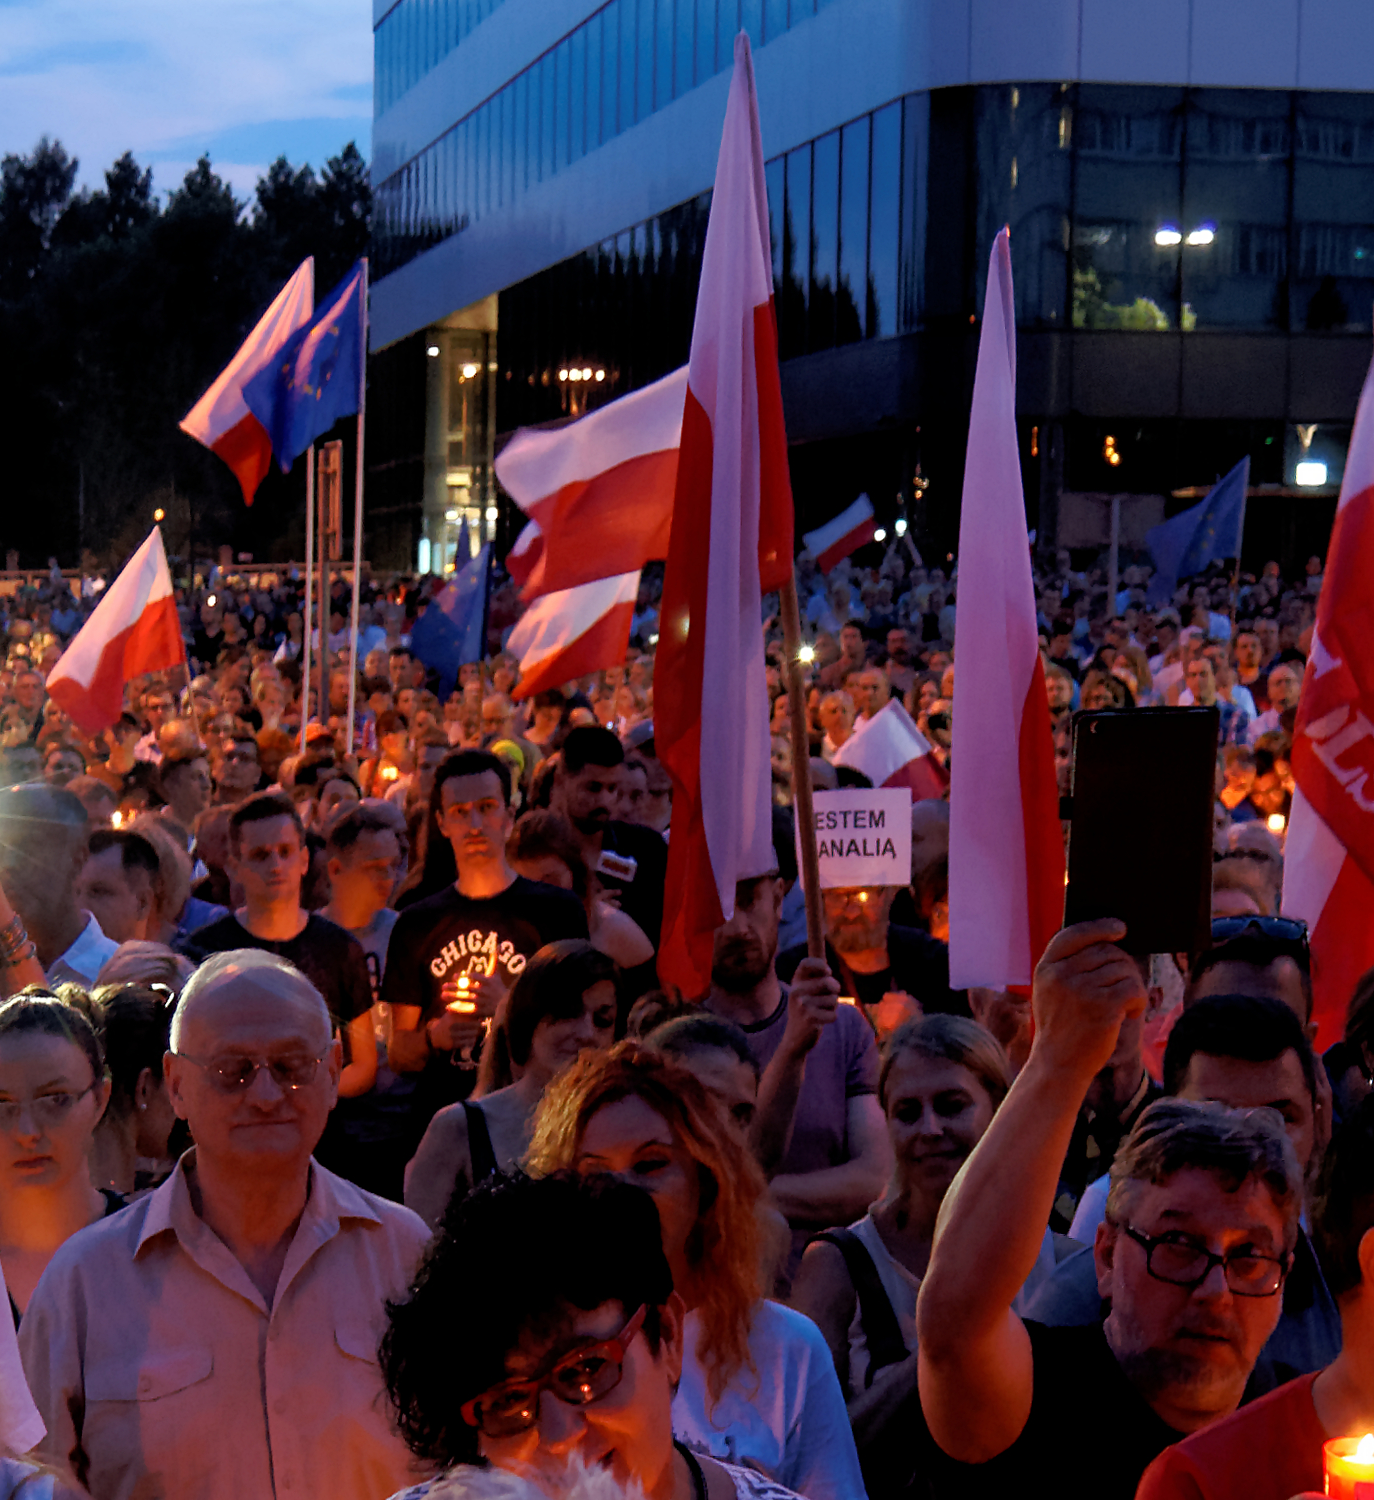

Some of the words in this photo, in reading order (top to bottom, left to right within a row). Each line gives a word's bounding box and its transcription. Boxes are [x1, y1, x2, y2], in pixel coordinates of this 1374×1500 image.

[814, 808, 886, 830] ESTEM
[817, 837, 897, 859] ANALIĄ
[429, 929, 526, 978] CHICAGO
